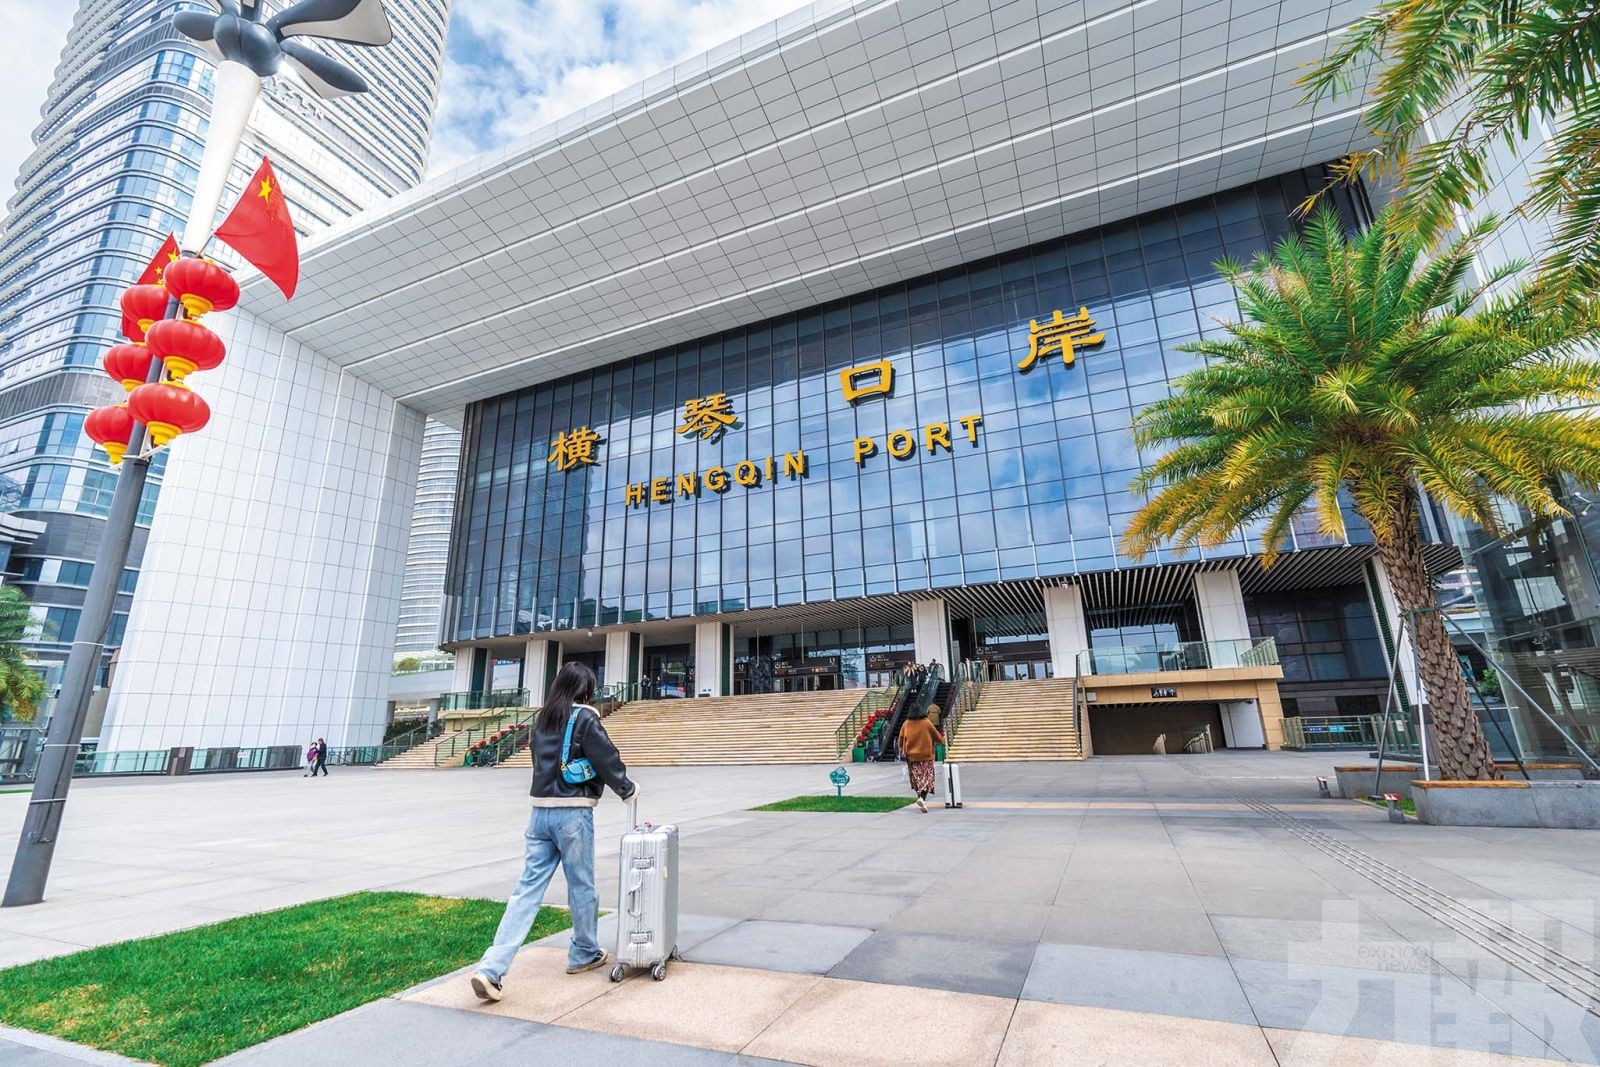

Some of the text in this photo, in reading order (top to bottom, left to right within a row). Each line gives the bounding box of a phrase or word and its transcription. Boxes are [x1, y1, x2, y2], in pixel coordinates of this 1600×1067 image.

[548, 306, 1106, 471] 横琴口岸
[625, 414, 983, 506] HENGQIN PORT
